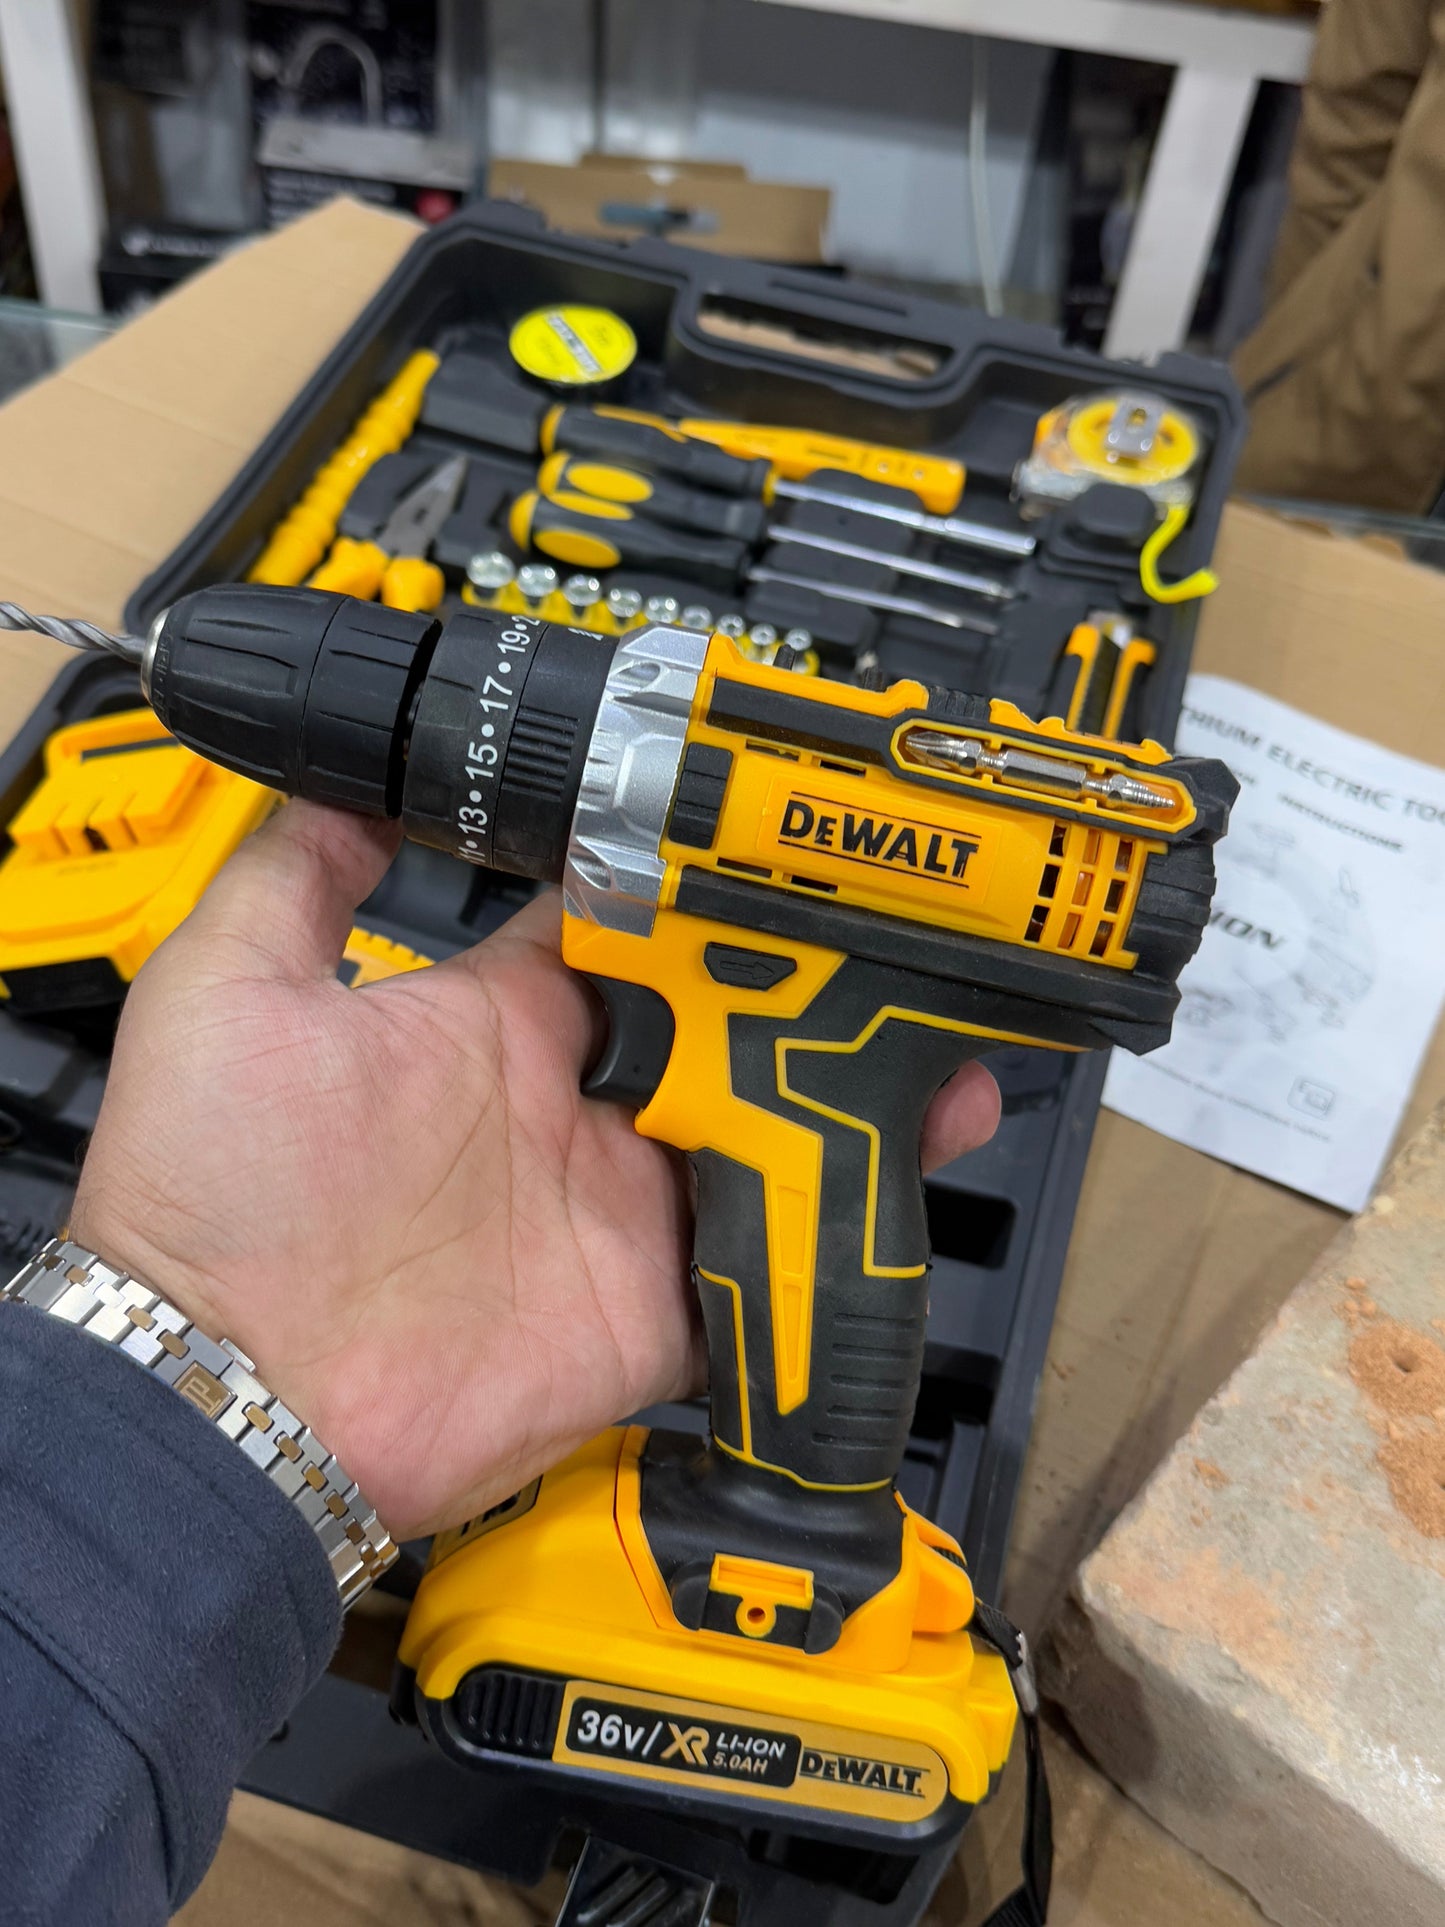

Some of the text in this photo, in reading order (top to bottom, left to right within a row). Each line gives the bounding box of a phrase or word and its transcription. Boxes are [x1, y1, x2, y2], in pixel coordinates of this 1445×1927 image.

[497, 630, 530, 654] 19
[480, 674, 513, 713] 17
[465, 742, 498, 781] 15
[1267, 743, 1394, 813] ELECTRIC
[458, 805, 488, 836] 13
[779, 799, 980, 878] DEWALT
[713, 1752, 768, 1775] 5.0AH
[716, 1732, 786, 1760] LI-ION
